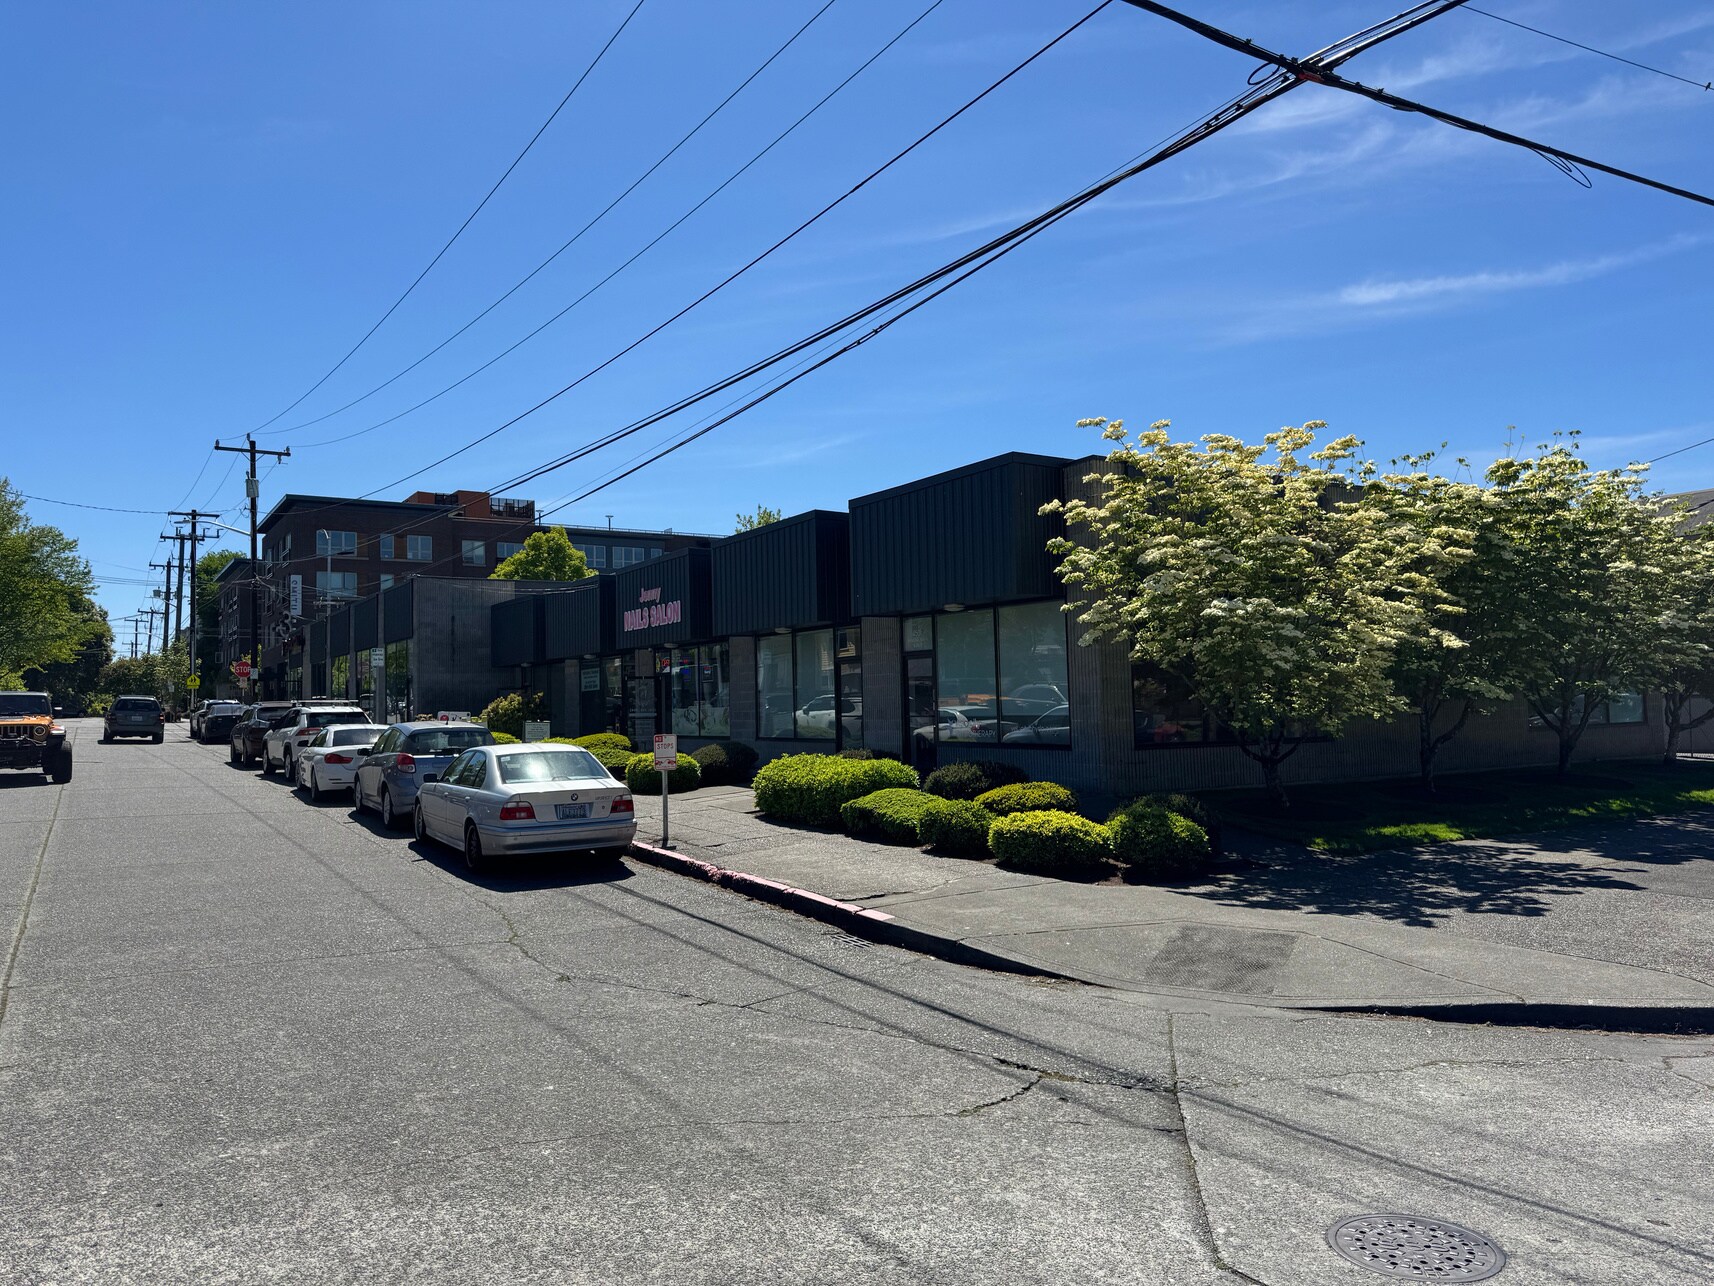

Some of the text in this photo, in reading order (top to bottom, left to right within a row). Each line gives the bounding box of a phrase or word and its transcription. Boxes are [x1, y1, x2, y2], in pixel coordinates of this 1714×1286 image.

[639, 587, 662, 603] Jenny
[623, 600, 682, 632] NAILS SALON
